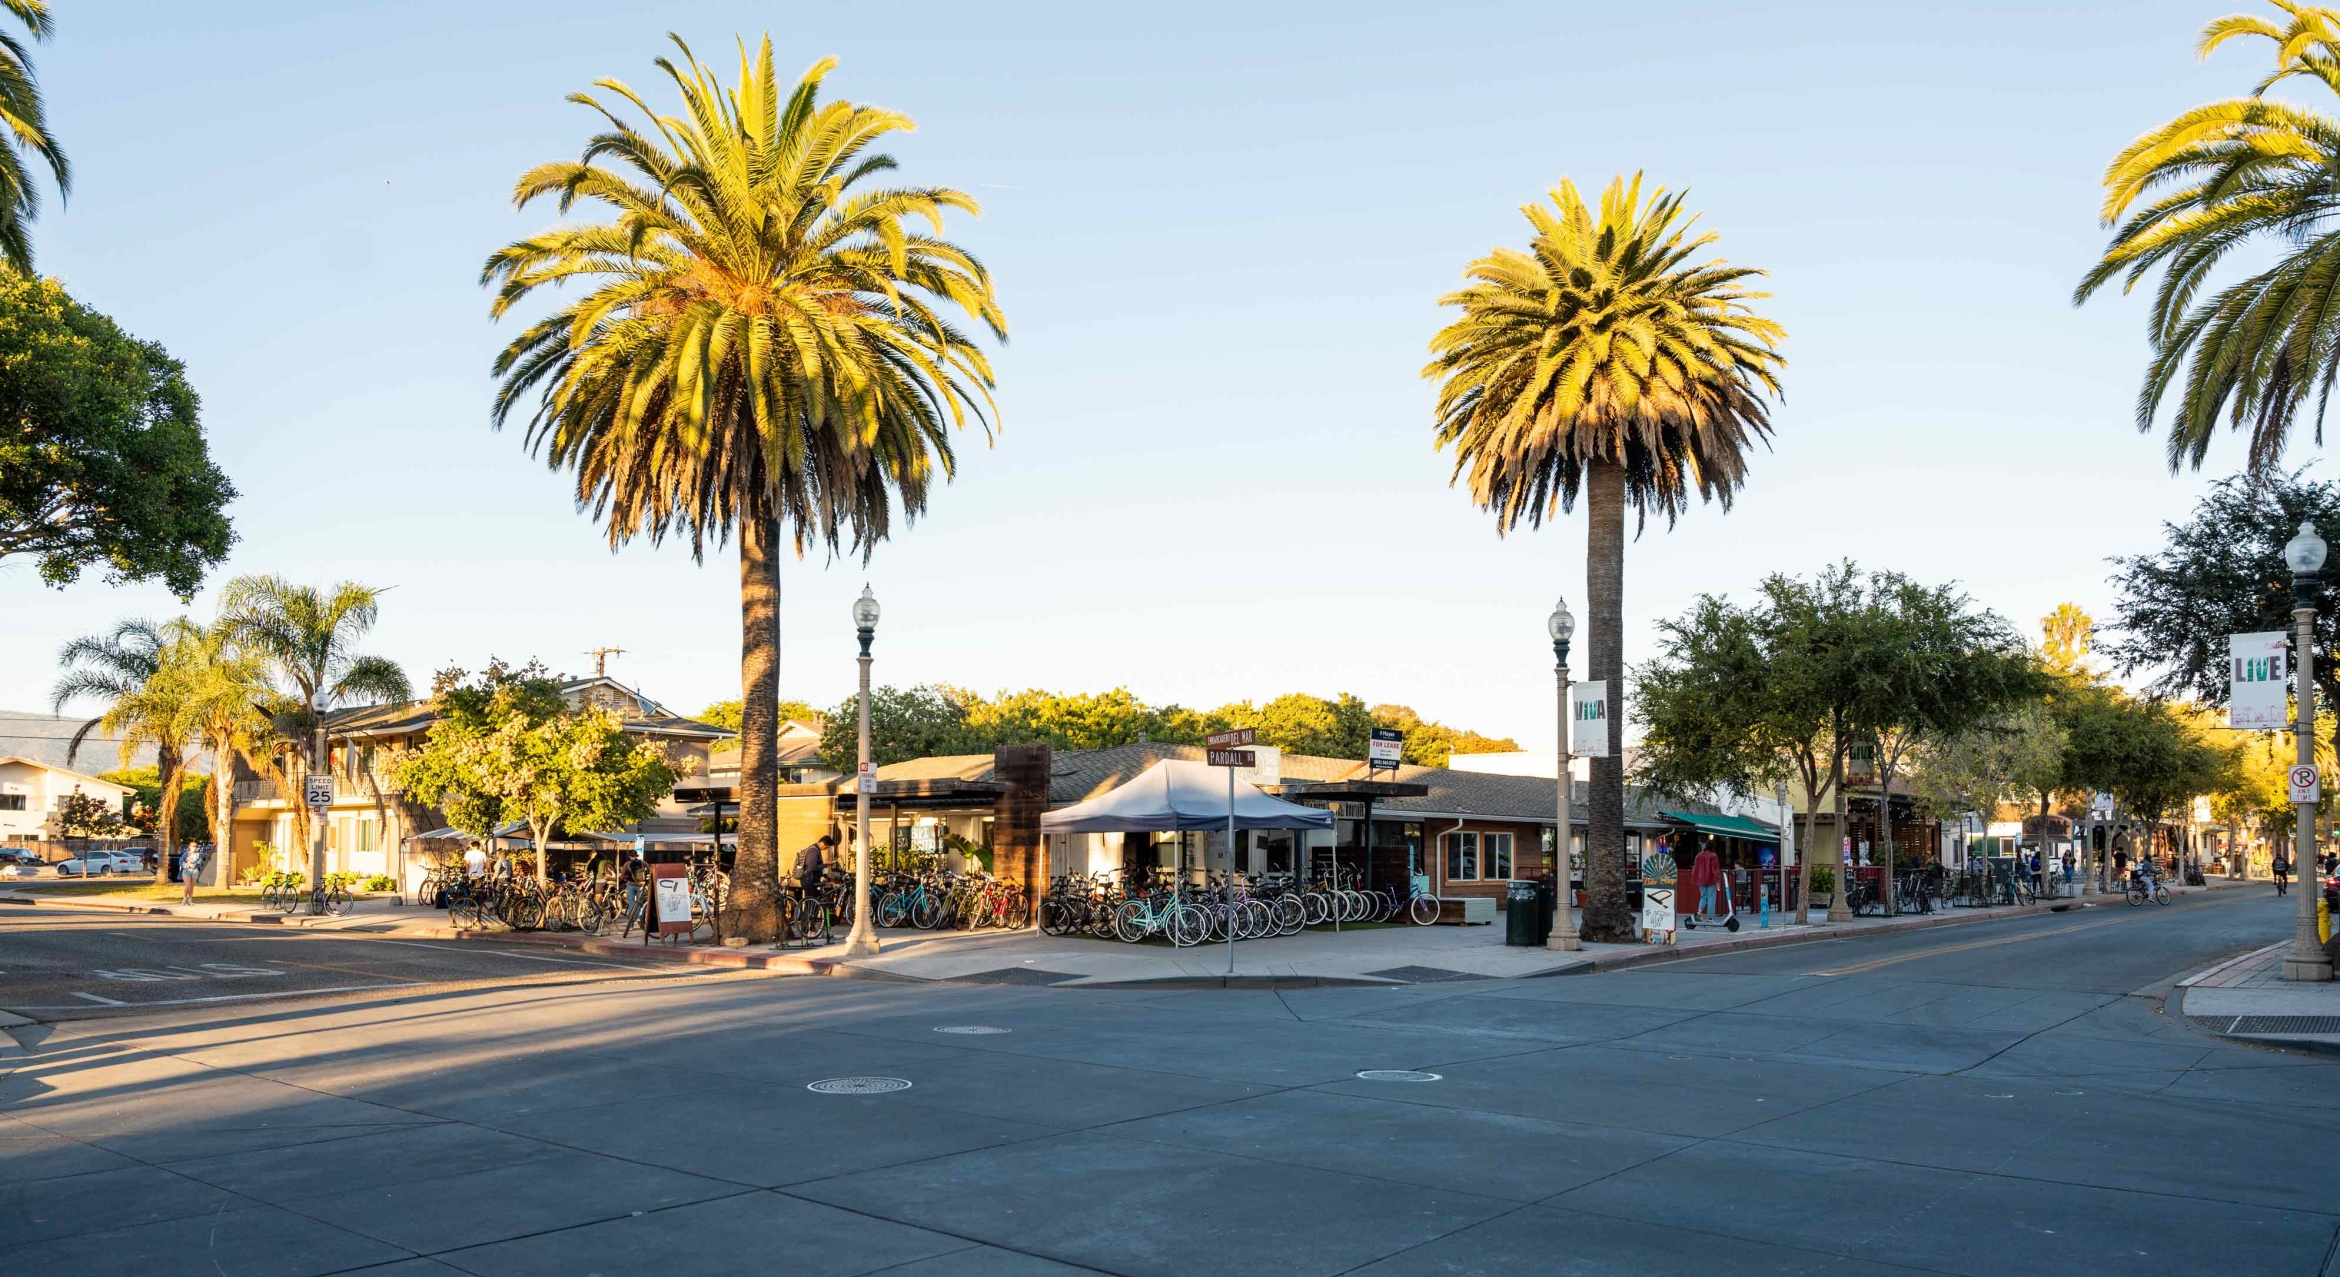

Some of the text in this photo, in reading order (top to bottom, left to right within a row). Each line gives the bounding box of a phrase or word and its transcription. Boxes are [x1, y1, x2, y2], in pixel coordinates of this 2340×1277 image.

[2235, 655, 2282, 682] LIVE
[1574, 699, 1606, 721] VIVA
[1230, 732, 1240, 746] DEL
[1241, 729, 1253, 743] MAR
[1210, 751, 1243, 765] PARDALL
[310, 790, 331, 802] 25
